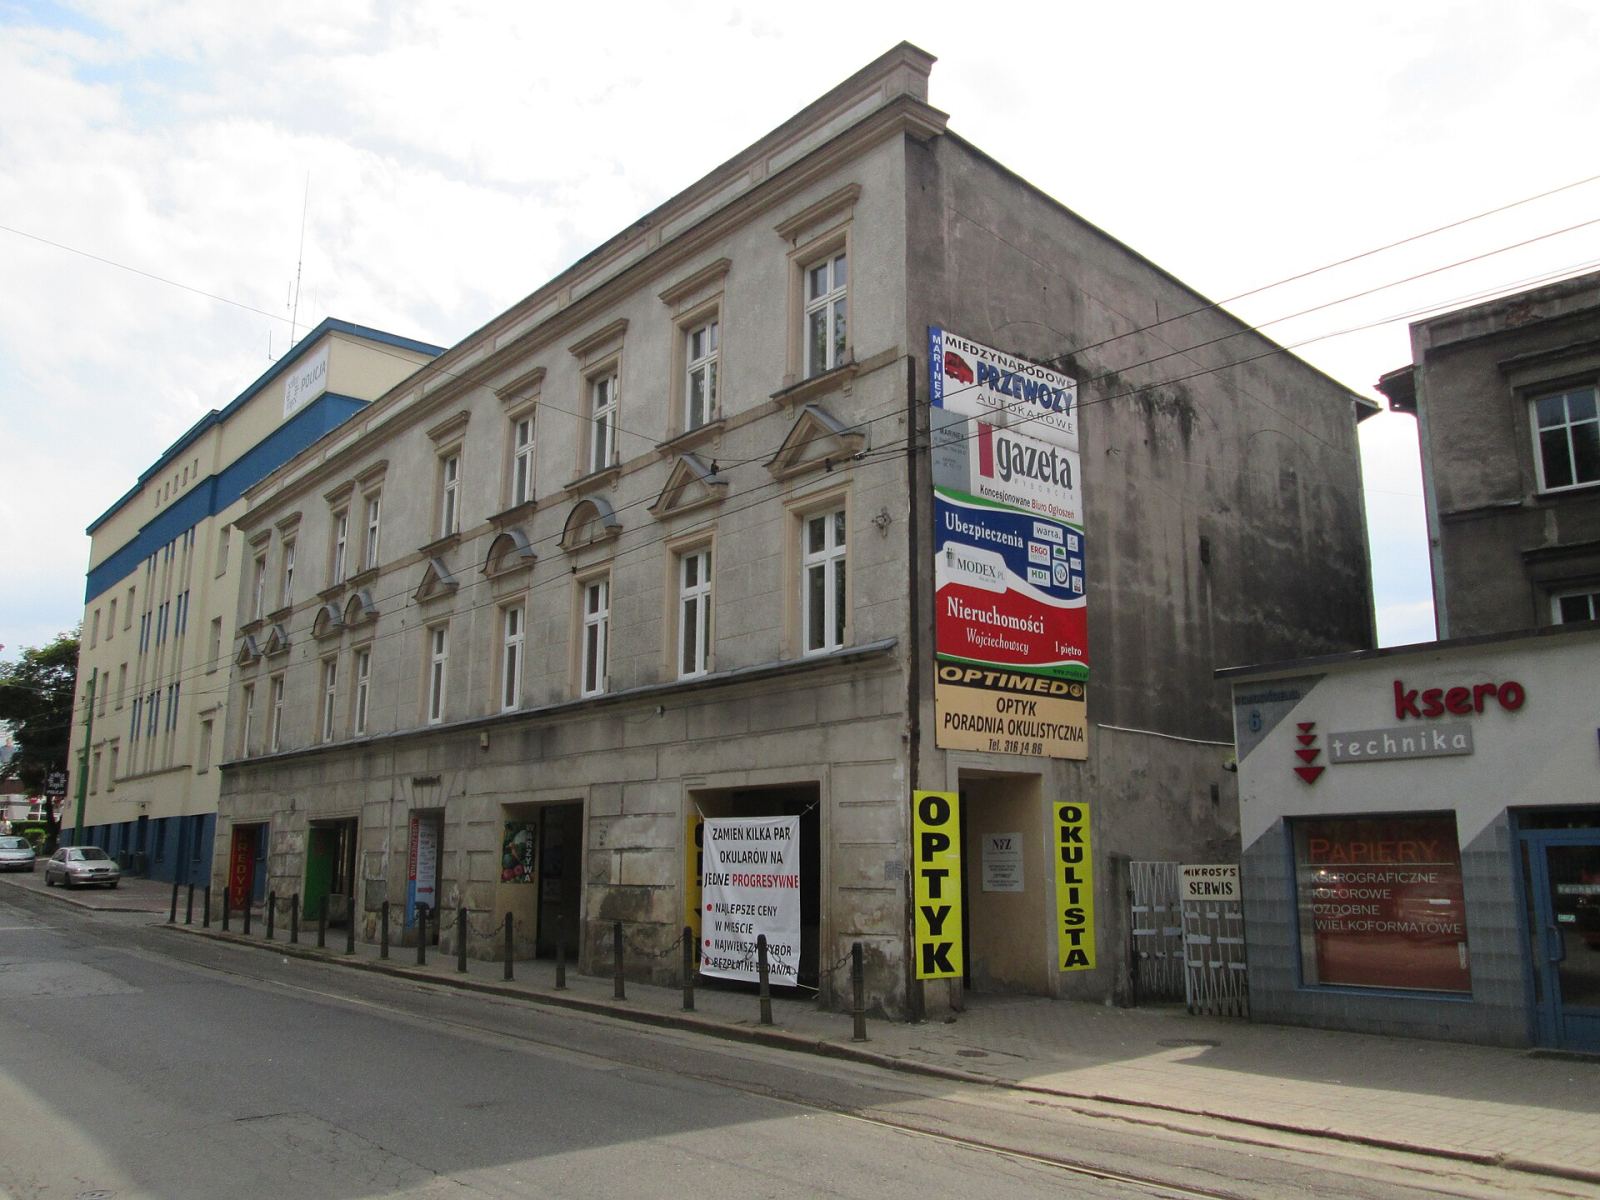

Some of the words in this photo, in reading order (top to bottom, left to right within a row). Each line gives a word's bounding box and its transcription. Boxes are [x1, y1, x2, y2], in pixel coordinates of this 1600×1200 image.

[932, 334, 942, 398] MARINEX
[976, 361, 1073, 417] PRZEWOZY
[976, 393, 1073, 430] AUTOKAROWE
[997, 437, 1073, 490] gazeta
[980, 484, 1031, 508] Koncesjonowane
[1031, 498, 1047, 512] Biuro
[944, 512, 1024, 549] Ubezpieczenia
[1030, 545, 1048, 556] ERGO
[956, 557, 997, 579] MODEX
[1031, 569, 1047, 580] HDI
[947, 596, 1045, 635] Nieruchomości
[966, 626, 1029, 656] Wojciechowscy
[1060, 643, 1082, 658] piętro
[939, 666, 1070, 696] OPTIMED
[996, 697, 1037, 717] OPTYK
[1393, 680, 1525, 720] ksero
[944, 713, 1004, 735] PORADNIA
[1007, 721, 1084, 743] OKULISTYCZNA
[1248, 710, 1261, 732] 6
[1332, 729, 1467, 757] technika
[713, 825, 744, 841] ZAMIEŃ
[746, 828, 771, 841] KILKA
[774, 827, 791, 841] PAR
[524, 824, 535, 882] WARZYWA
[720, 848, 768, 864] OKULARÓW
[770, 851, 783, 864] NA
[1310, 838, 1438, 863] PAPIERY
[704, 873, 730, 888] JEDNE
[732, 874, 799, 889] PROGRESYWNE
[1184, 867, 1236, 877] MIKROSYS
[1311, 872, 1438, 884] KSEROGRAFICZNE
[918, 796, 956, 974] OPTYK
[1058, 806, 1090, 968] OKULISTA
[1189, 881, 1233, 895] SERWIS
[1312, 888, 1392, 899] KOLOROWE
[715, 903, 755, 917] NAJLEPSZE
[757, 905, 777, 917] CENY
[1313, 904, 1380, 915] OZDOBNE
[715, 921, 723, 932] W
[1315, 920, 1463, 934] WIELKOFORMATOWE
[713, 957, 754, 972] BEZPŁATNE
